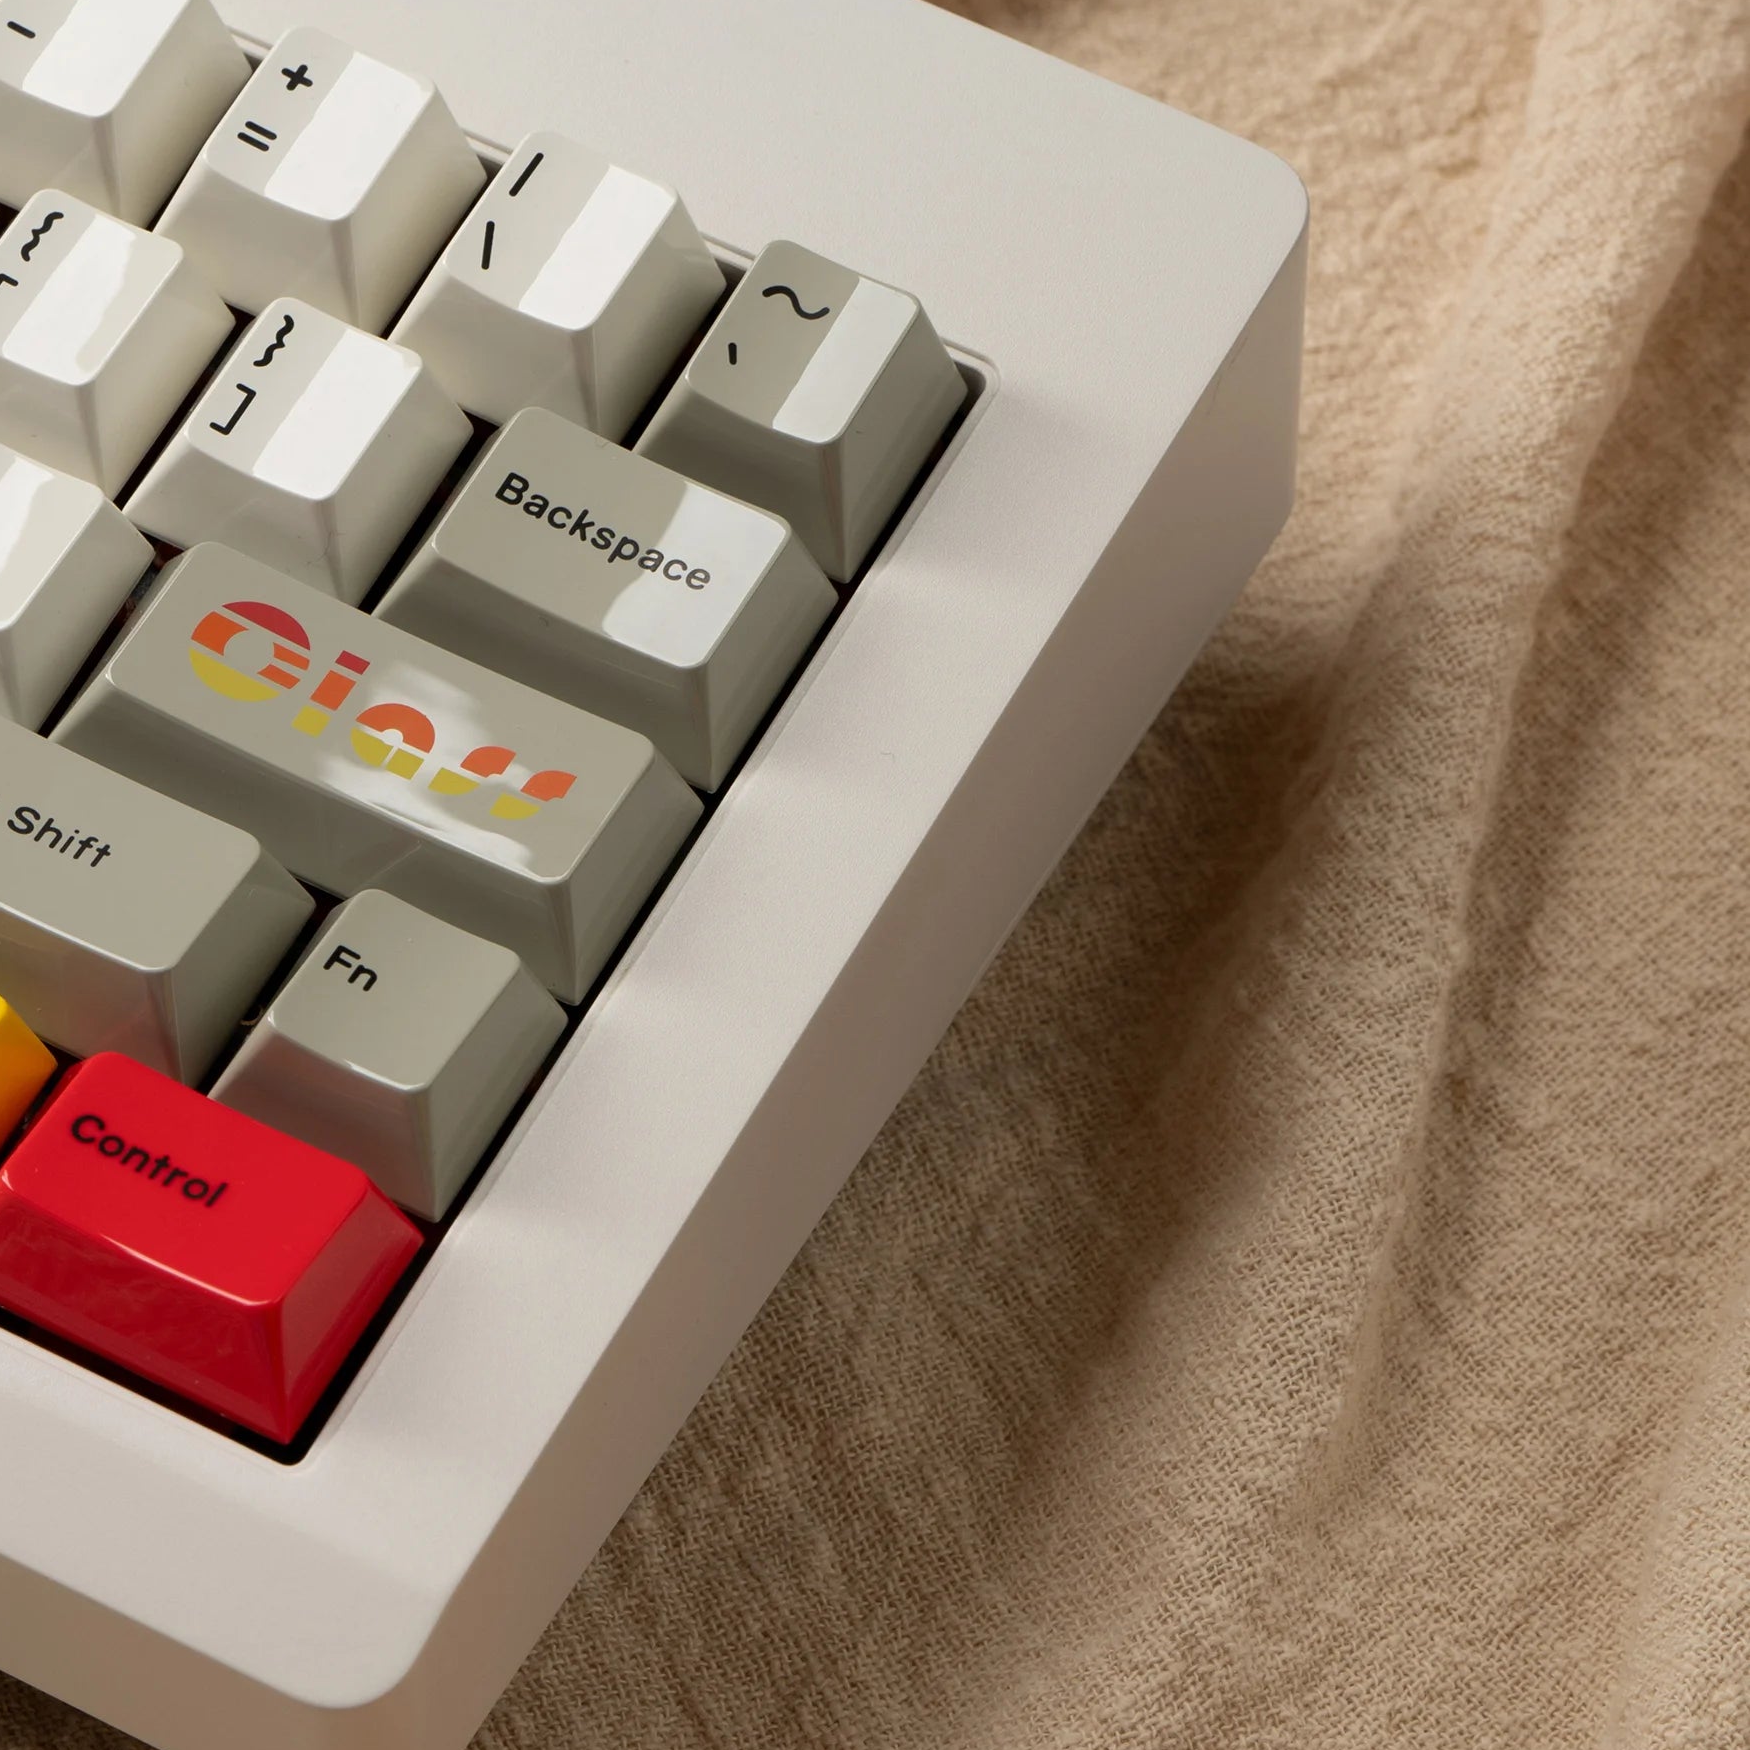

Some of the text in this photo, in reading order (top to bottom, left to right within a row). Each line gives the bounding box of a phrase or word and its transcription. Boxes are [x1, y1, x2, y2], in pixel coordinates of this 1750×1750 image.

[282, 65, 313, 90] +
[238, 121, 277, 151] =
[21, 211, 64, 261] {
[762, 286, 829, 320] ~
[253, 315, 294, 367] }
[210, 383, 256, 436] ]
[494, 472, 711, 591] Backspace
[7, 807, 110, 867] Shift
[323, 945, 377, 991] Fn
[70, 1114, 228, 1208] Control
